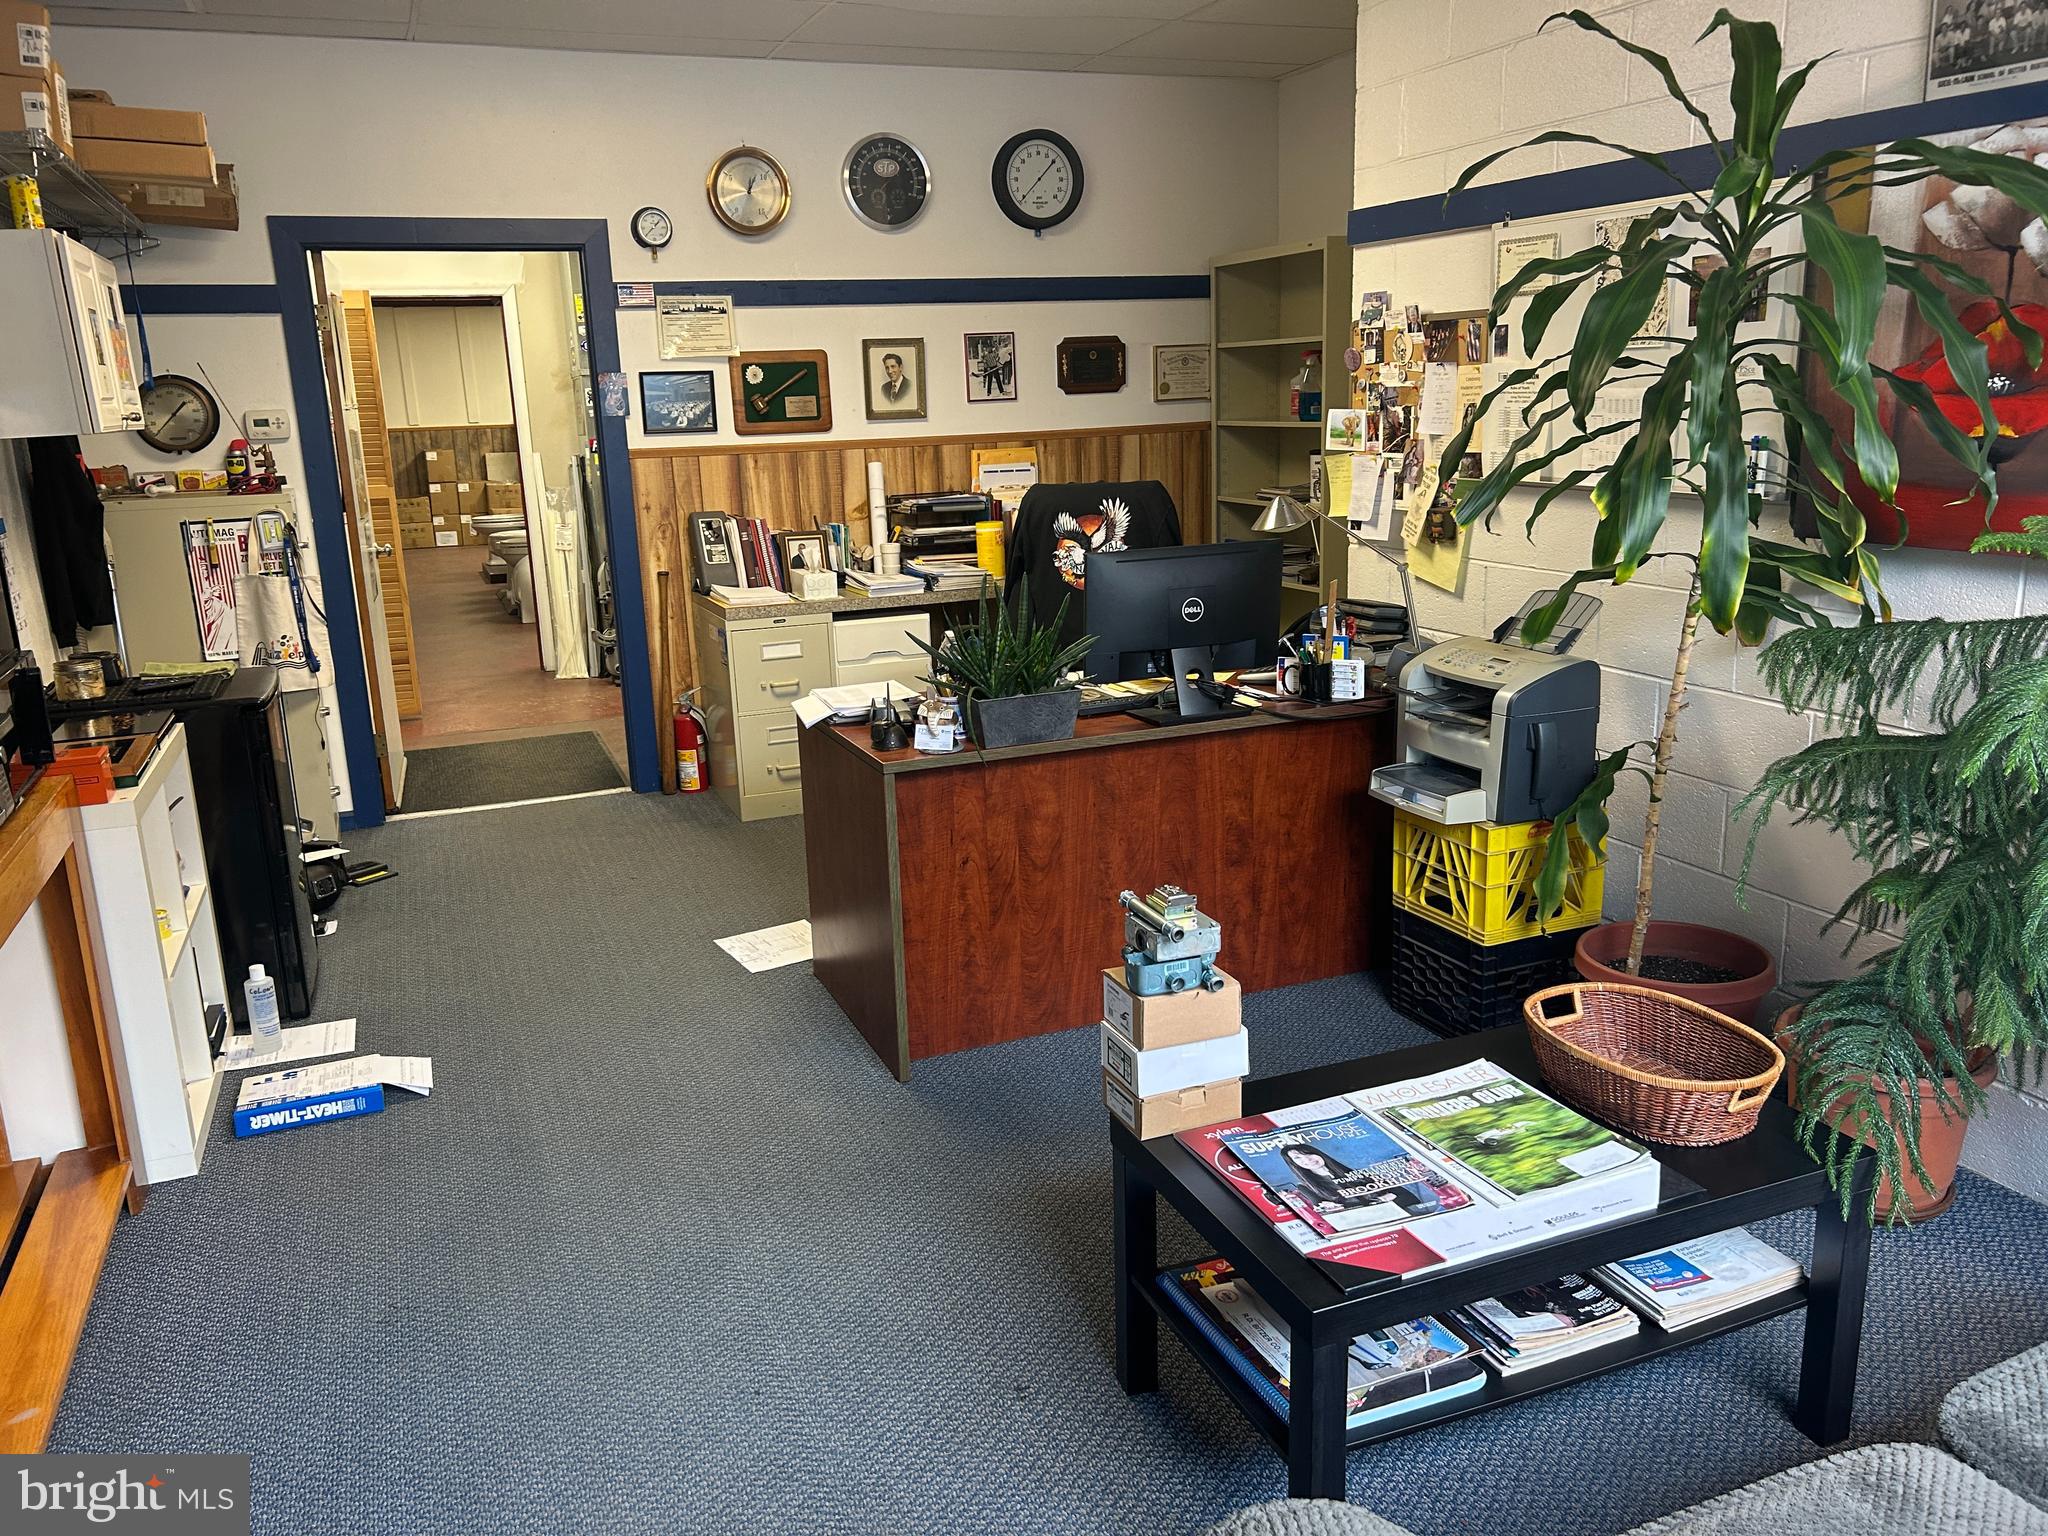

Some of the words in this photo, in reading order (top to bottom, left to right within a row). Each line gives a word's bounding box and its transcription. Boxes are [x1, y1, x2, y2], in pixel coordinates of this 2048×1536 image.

[877, 161, 895, 173] STP
[1362, 1067, 1493, 1106] WHOLESALER
[250, 1099, 343, 1130] HEAT-TIMER
[1204, 1125, 1245, 1140] xylem
[1337, 1172, 1427, 1198] BROOKHART
[1252, 1323, 1273, 1343] BITZER
